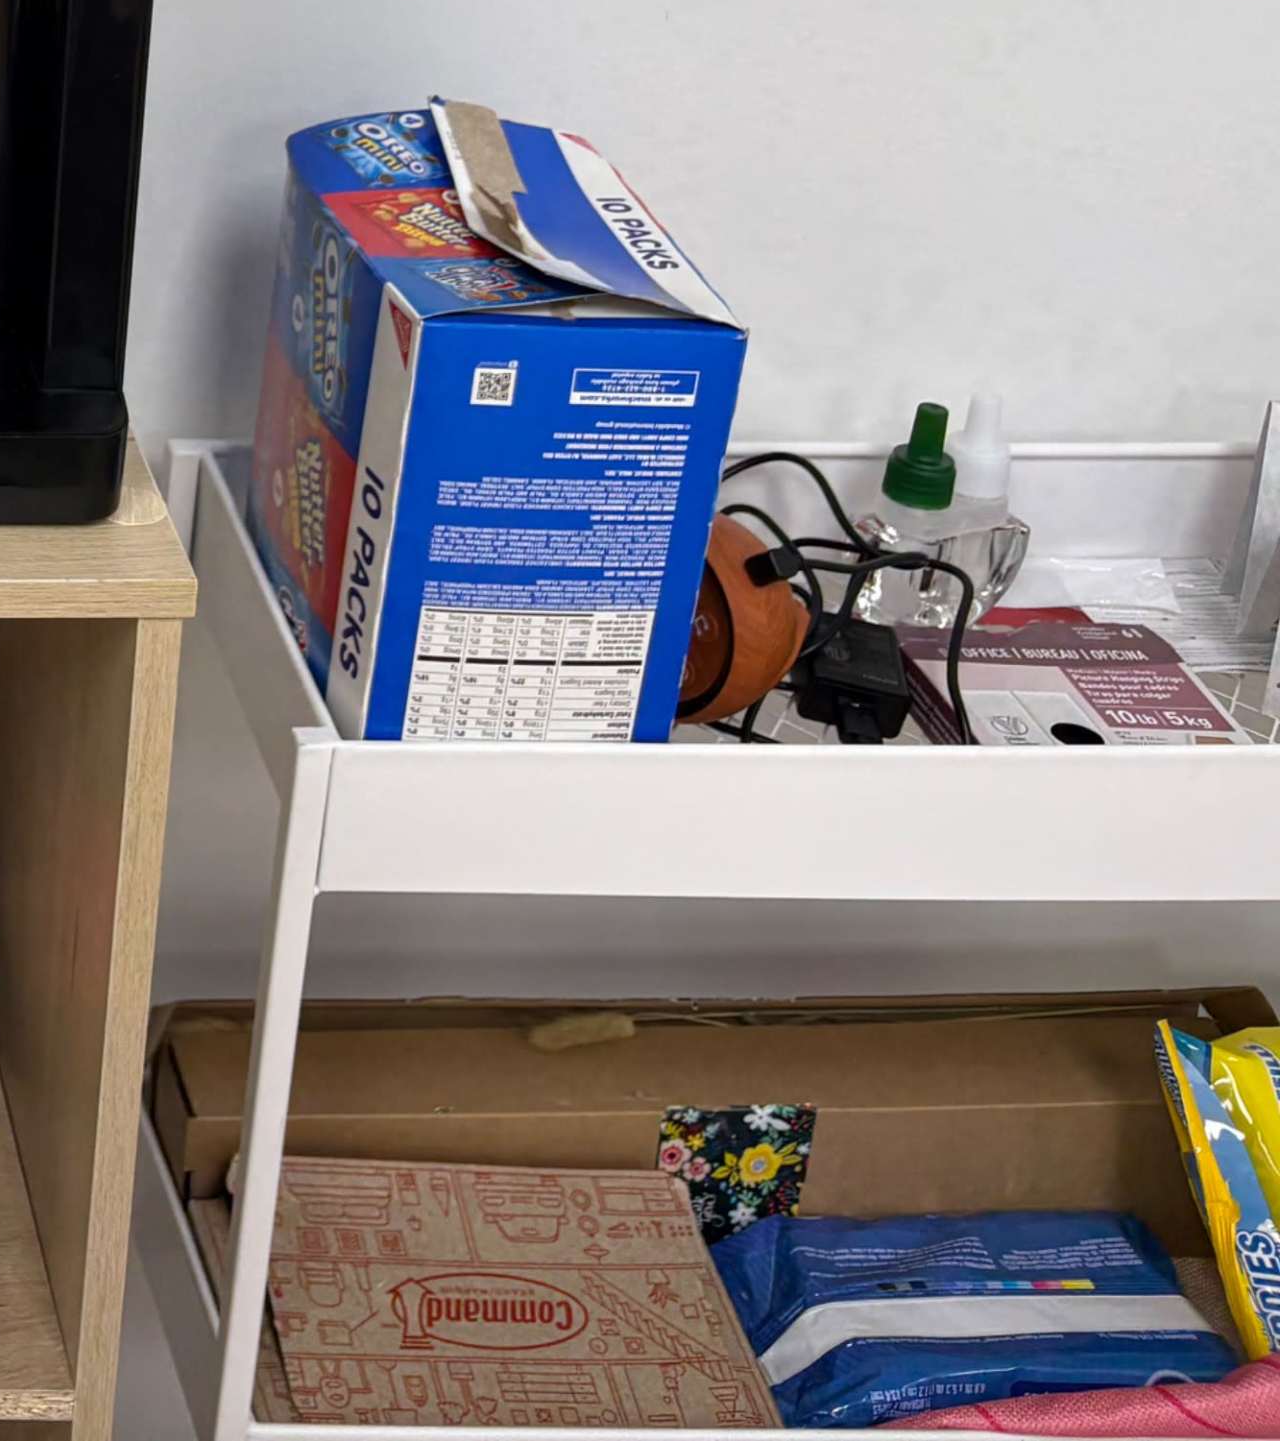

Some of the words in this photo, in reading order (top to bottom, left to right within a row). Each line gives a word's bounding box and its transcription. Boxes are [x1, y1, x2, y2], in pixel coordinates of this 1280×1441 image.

[355, 138, 404, 172] mini
[357, 122, 425, 174] OREO
[596, 197, 632, 213] 10
[611, 218, 680, 270] PACKS
[312, 272, 325, 375] mini
[321, 235, 339, 402] OREO
[362, 467, 385, 521] 10
[339, 526, 377, 680] PACKS
[962, 647, 1011, 660] OFFICE
[1022, 648, 1079, 660] BUREAU
[1089, 648, 1149, 661] OFICINA
[426, 1297, 573, 1330] Command
